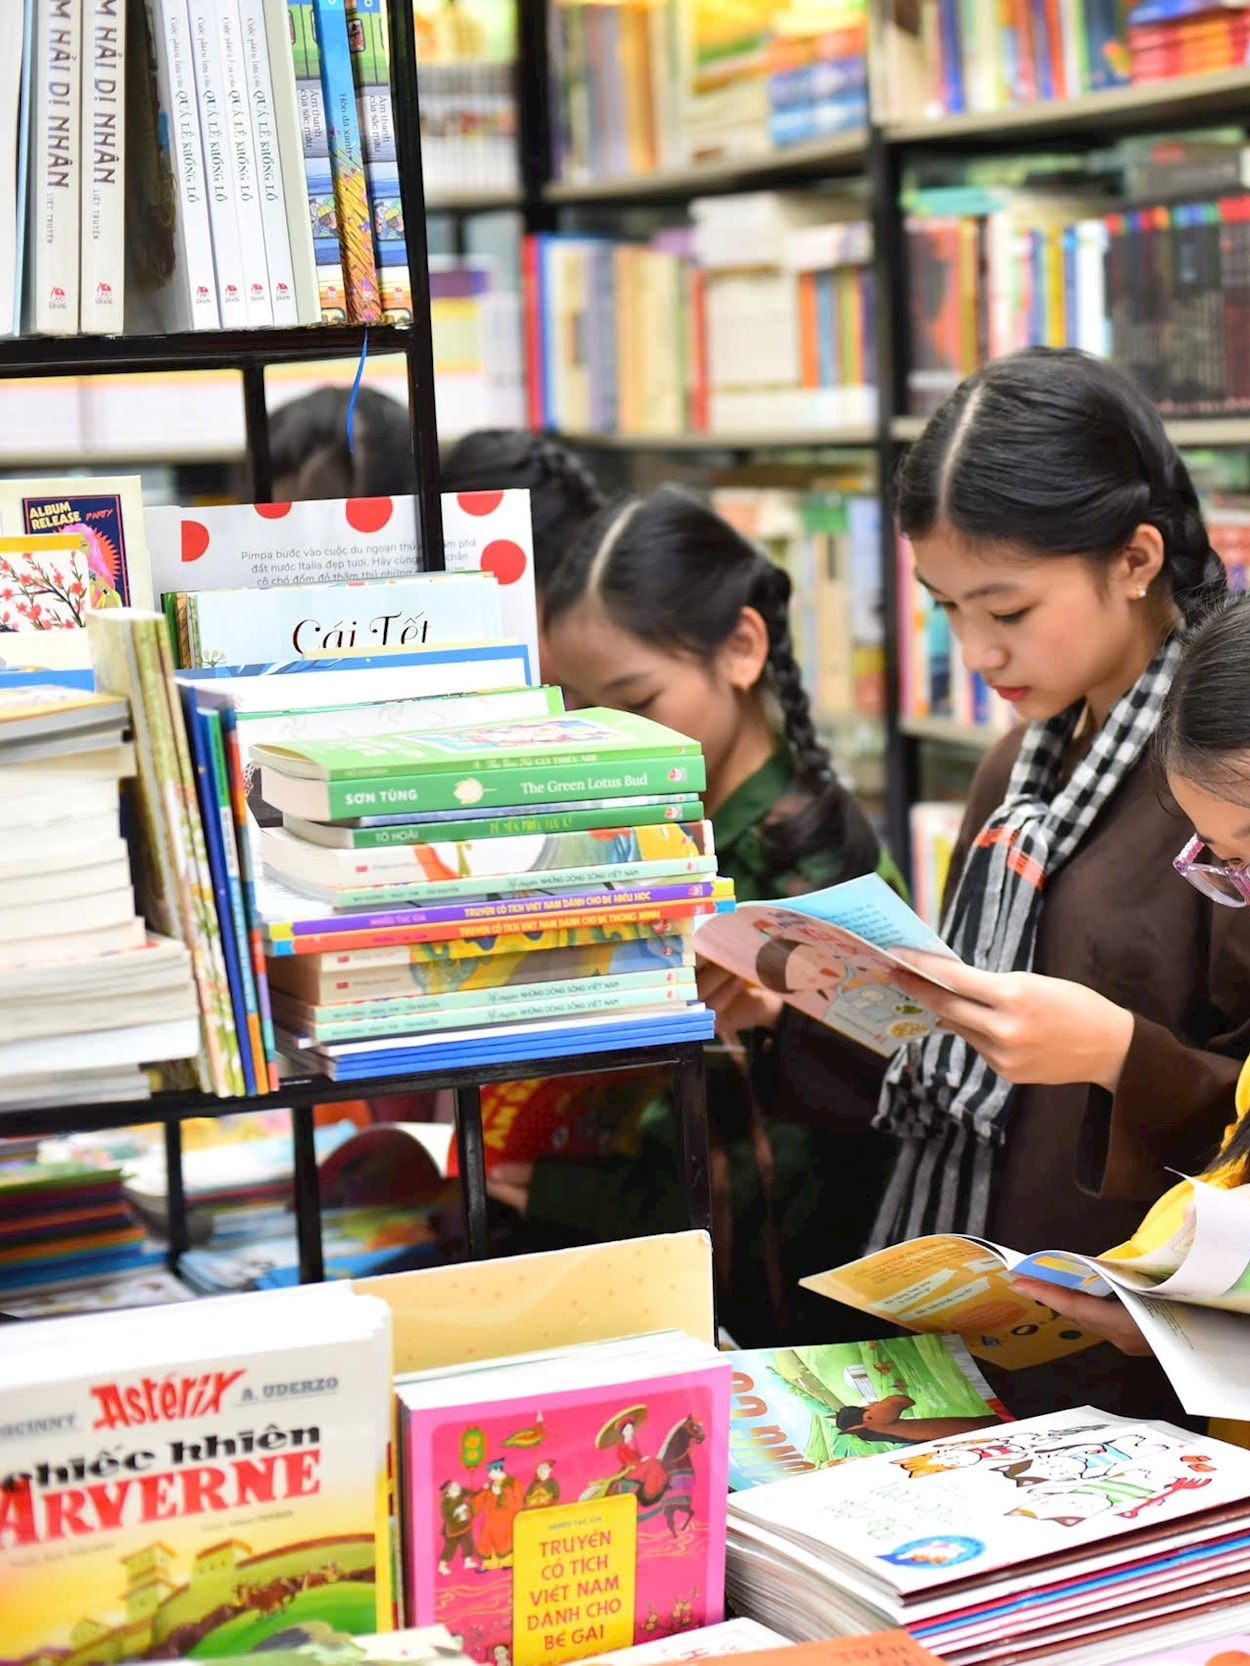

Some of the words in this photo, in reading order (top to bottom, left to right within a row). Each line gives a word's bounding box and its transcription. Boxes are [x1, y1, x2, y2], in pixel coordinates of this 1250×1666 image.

[50, 29, 76, 70] HẢI
[95, 27, 122, 69] HẢI
[48, 82, 71, 106] DỊ
[94, 78, 116, 103] DỊ
[47, 116, 73, 189] NHÂN
[94, 112, 119, 185] NHÂN
[30, 501, 71, 519] ALBUM
[31, 511, 81, 530] RELEASE
[86, 508, 113, 521] PARTY
[241, 551, 273, 561] Pimpa
[276, 547, 301, 559] bước
[303, 547, 321, 557] vào
[324, 545, 347, 557] cuộc
[350, 545, 363, 555] du
[366, 543, 397, 557] ngoạn
[251, 563, 268, 575] đất
[271, 561, 297, 572] nước
[298, 560, 322, 571] Italia
[326, 558, 344, 571] đẹp
[372, 556, 392, 567] Hãy
[293, 619, 356, 654] Cái
[369, 611, 432, 645] Tết
[521, 783, 544, 795] The
[547, 779, 584, 793] Green
[587, 777, 621, 789] Lotus
[624, 774, 648, 787] Bud
[345, 793, 375, 805] SƠN
[381, 789, 418, 801] TÙNG
[375, 831, 389, 842] TÔ
[392, 829, 419, 841] HOÀI
[625, 869, 639, 877] NAM
[526, 902, 542, 912] VIỆT
[544, 900, 562, 910] NAM
[586, 896, 601, 906] CHO
[539, 919, 557, 929] NAM
[582, 915, 597, 925] CHO
[90, 1368, 249, 1431] Astérix
[242, 1387, 259, 1402] A.
[263, 1376, 340, 1400] UDERZO
[169, 1423, 322, 1466] khiên
[577, 1575, 620, 1598] NAM
[586, 1598, 622, 1619] CHO
